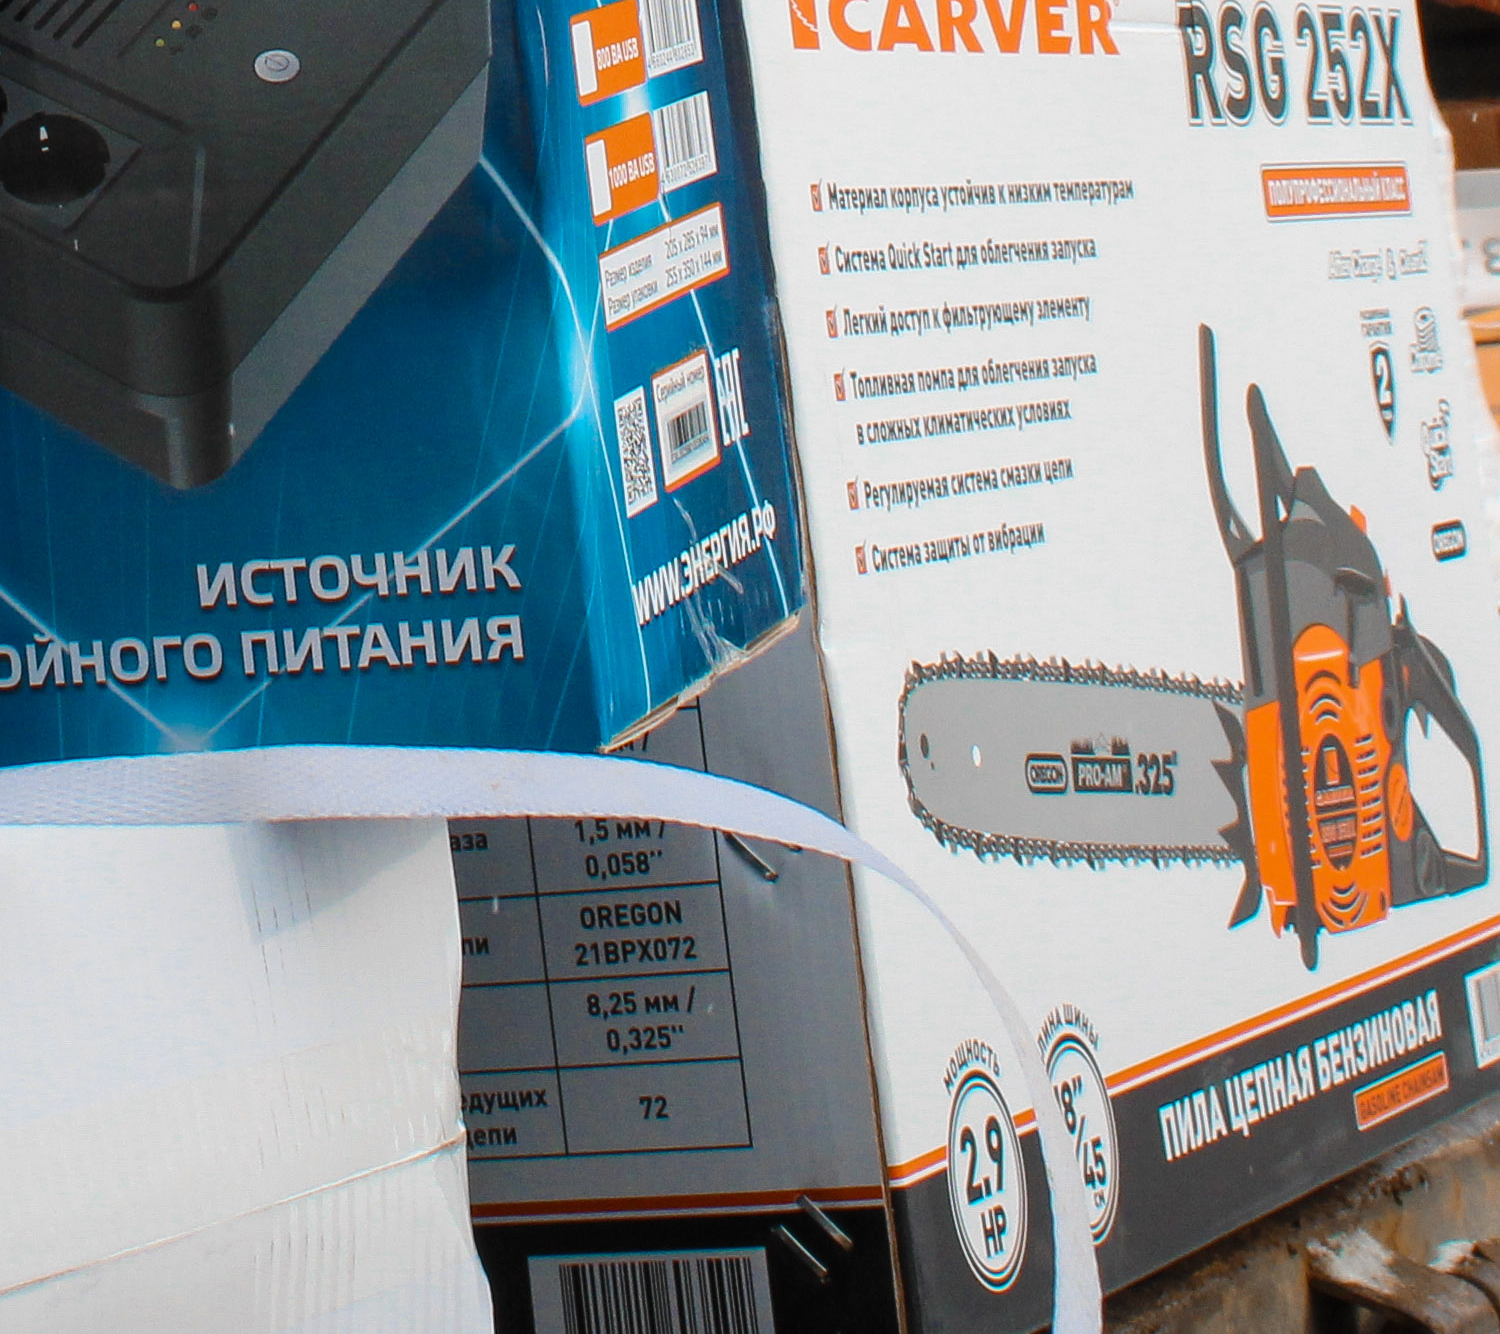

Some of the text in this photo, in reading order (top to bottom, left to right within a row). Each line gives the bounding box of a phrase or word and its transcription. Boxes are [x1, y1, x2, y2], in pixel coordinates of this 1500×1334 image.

[1176, 0, 1413, 127] RSG 252X
[827, 180, 1135, 215] Материал корпуса устойчив низким температурам
[835, 238, 1097, 273] Система Quick Start для облегчения запуска
[843, 296, 1091, 336] Легкий доступ фильтрующему элементу
[850, 354, 1097, 399] Топливная помпа для облегчения запуска
[867, 399, 1073, 444] сложных климатических условиях
[864, 458, 1074, 511] Регулируемая система смазки цепи
[631, 499, 777, 626] WWW.ЭНЕРГИЯ.РФ
[872, 522, 1046, 573] Система защиты вибрации
[196, 544, 522, 609] ИСТОЧНИК
[240, 615, 525, 677] ПИТАНИЯ
[580, 900, 683, 929] OREGON
[575, 936, 698, 967] 21BPX072
[587, 990, 679, 1017] 8,25 мм
[1065, 1003, 1100, 1051] ШИНЫ
[943, 1042, 1001, 1094] МОЩНОСТЬ
[1158, 989, 1443, 1161] ПИЛА ЦЕПНАЯ БЕНЗИНОВАЯ
[639, 1097, 669, 1119] 72
[1357, 1074, 1400, 1123] GASOLINE
[960, 1115, 1004, 1206] 2.9
[979, 1204, 1008, 1260] HP
